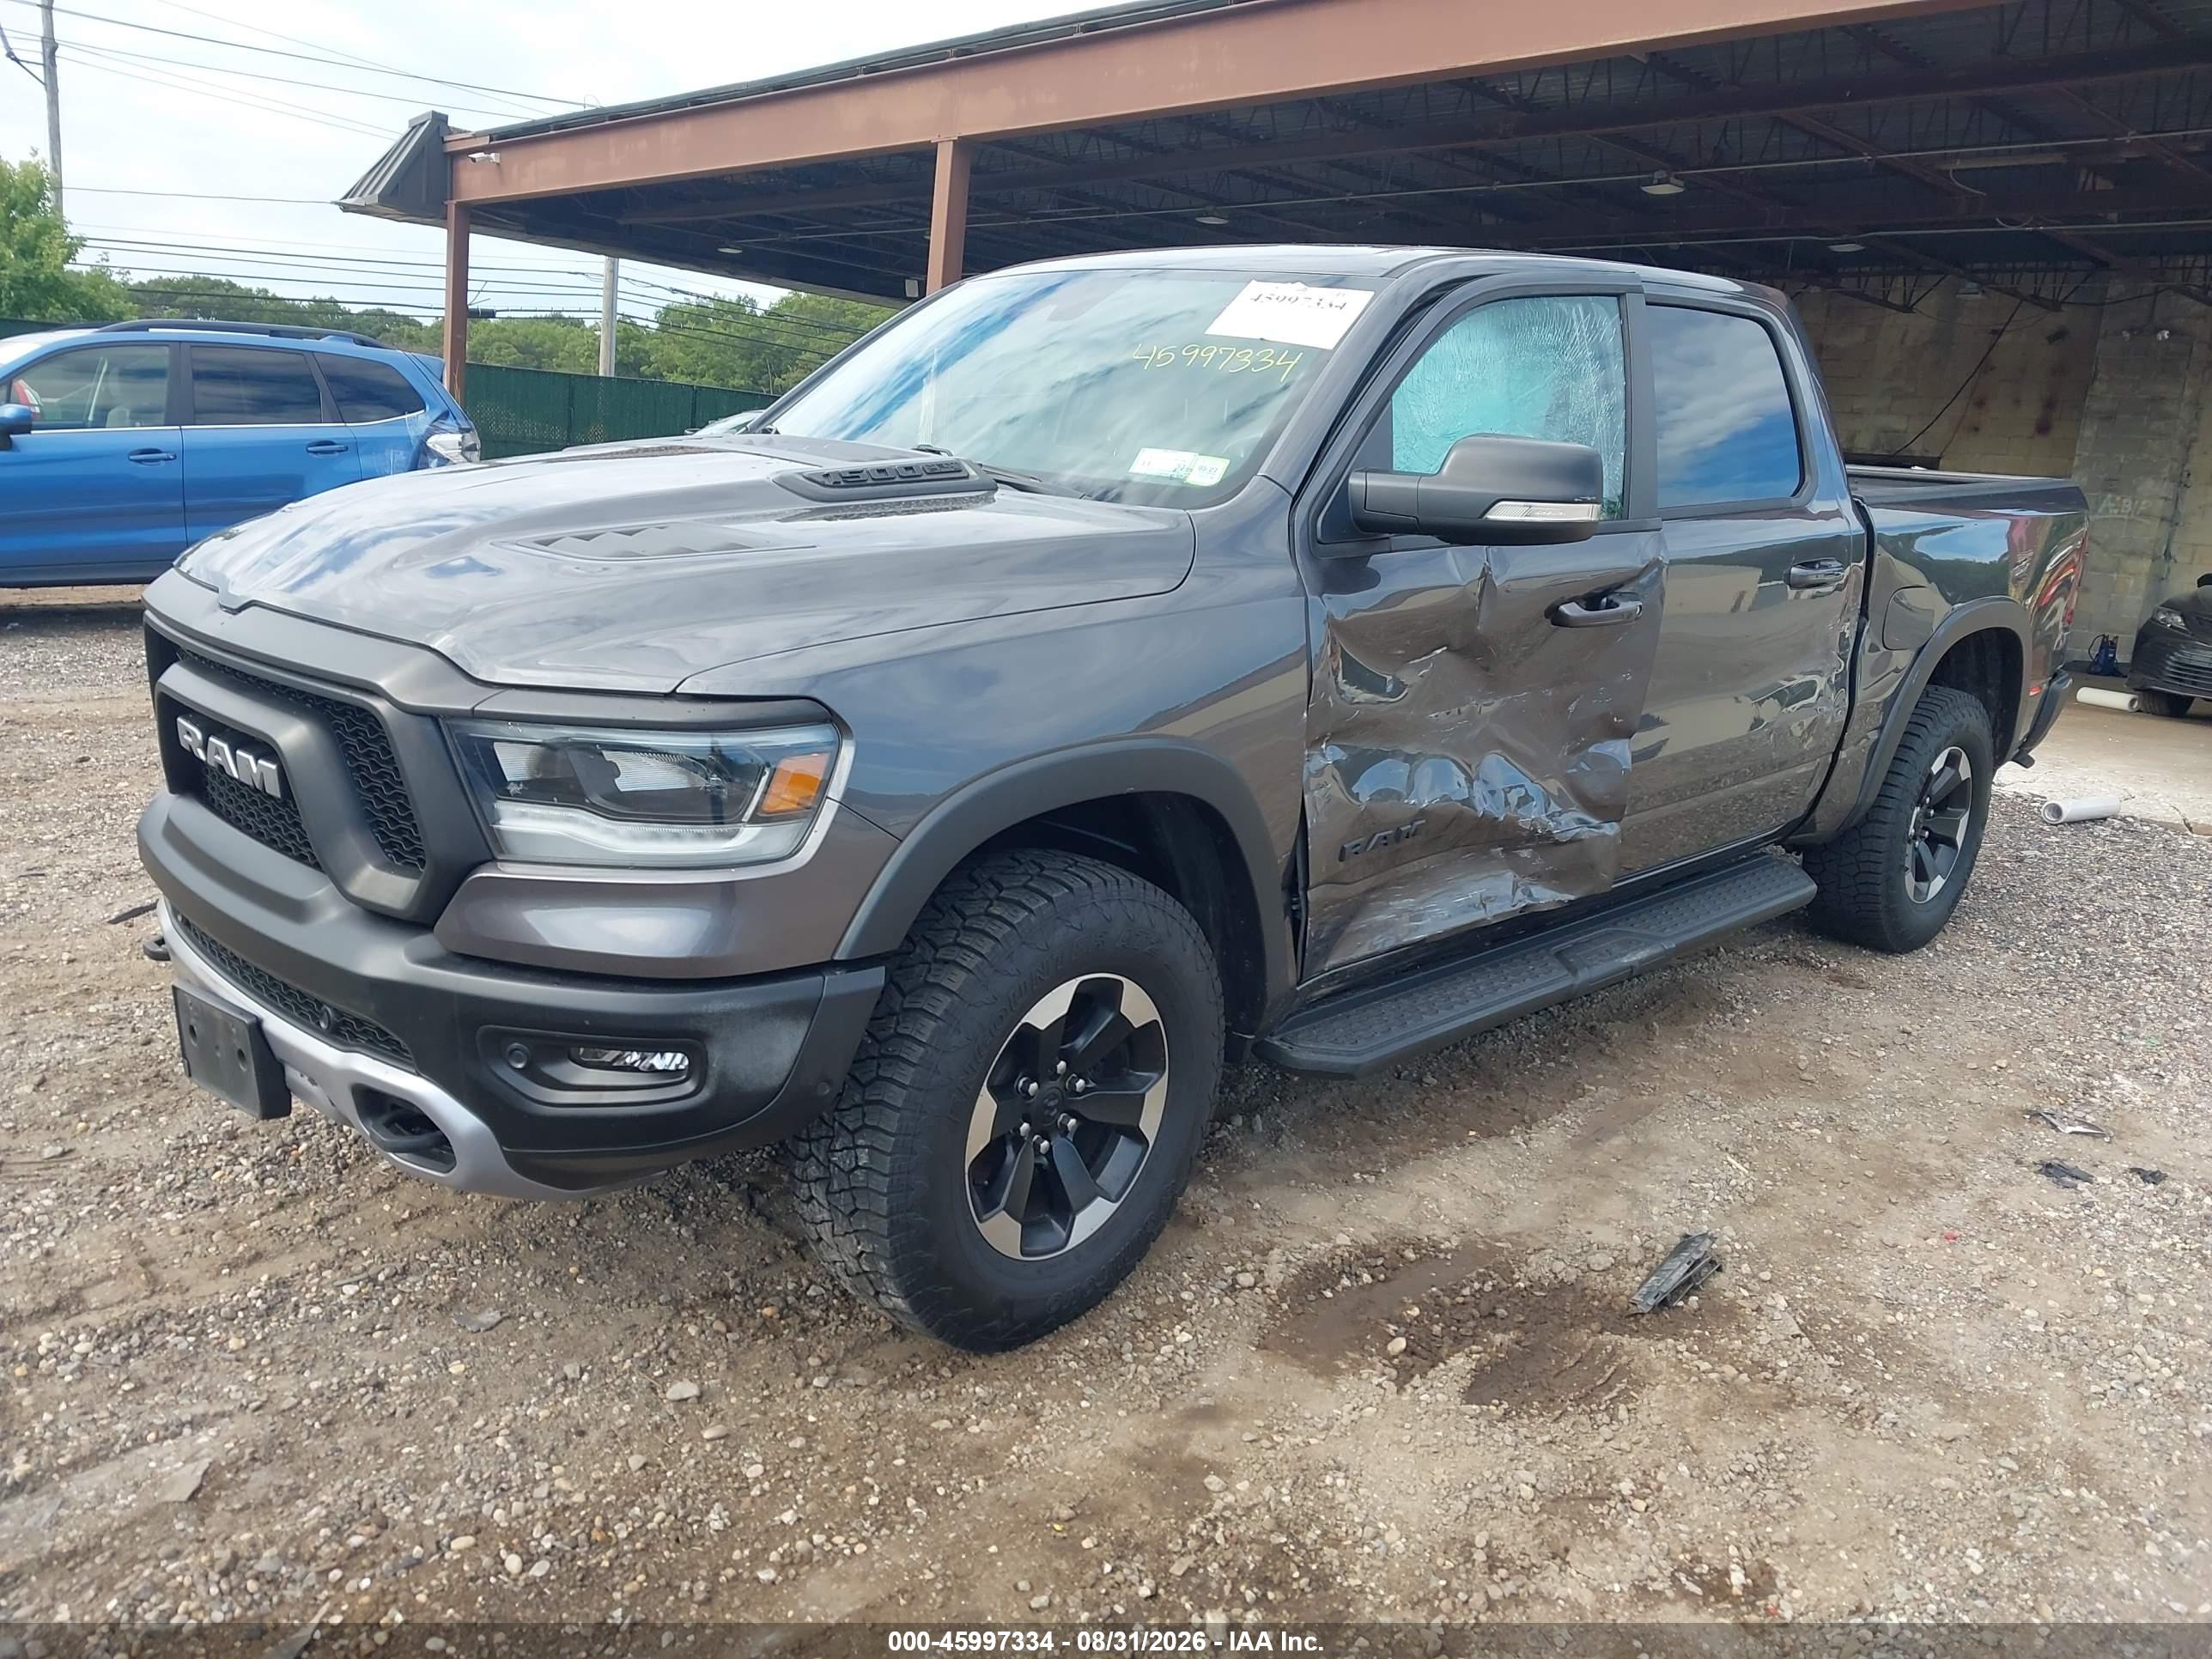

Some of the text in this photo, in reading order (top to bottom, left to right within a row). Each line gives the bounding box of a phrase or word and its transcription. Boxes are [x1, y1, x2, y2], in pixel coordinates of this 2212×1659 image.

[1132, 343, 1304, 383] 45997334
[822, 465, 923, 484] 1500
[177, 715, 282, 799] RAM
[1338, 818, 1427, 862] RAM
